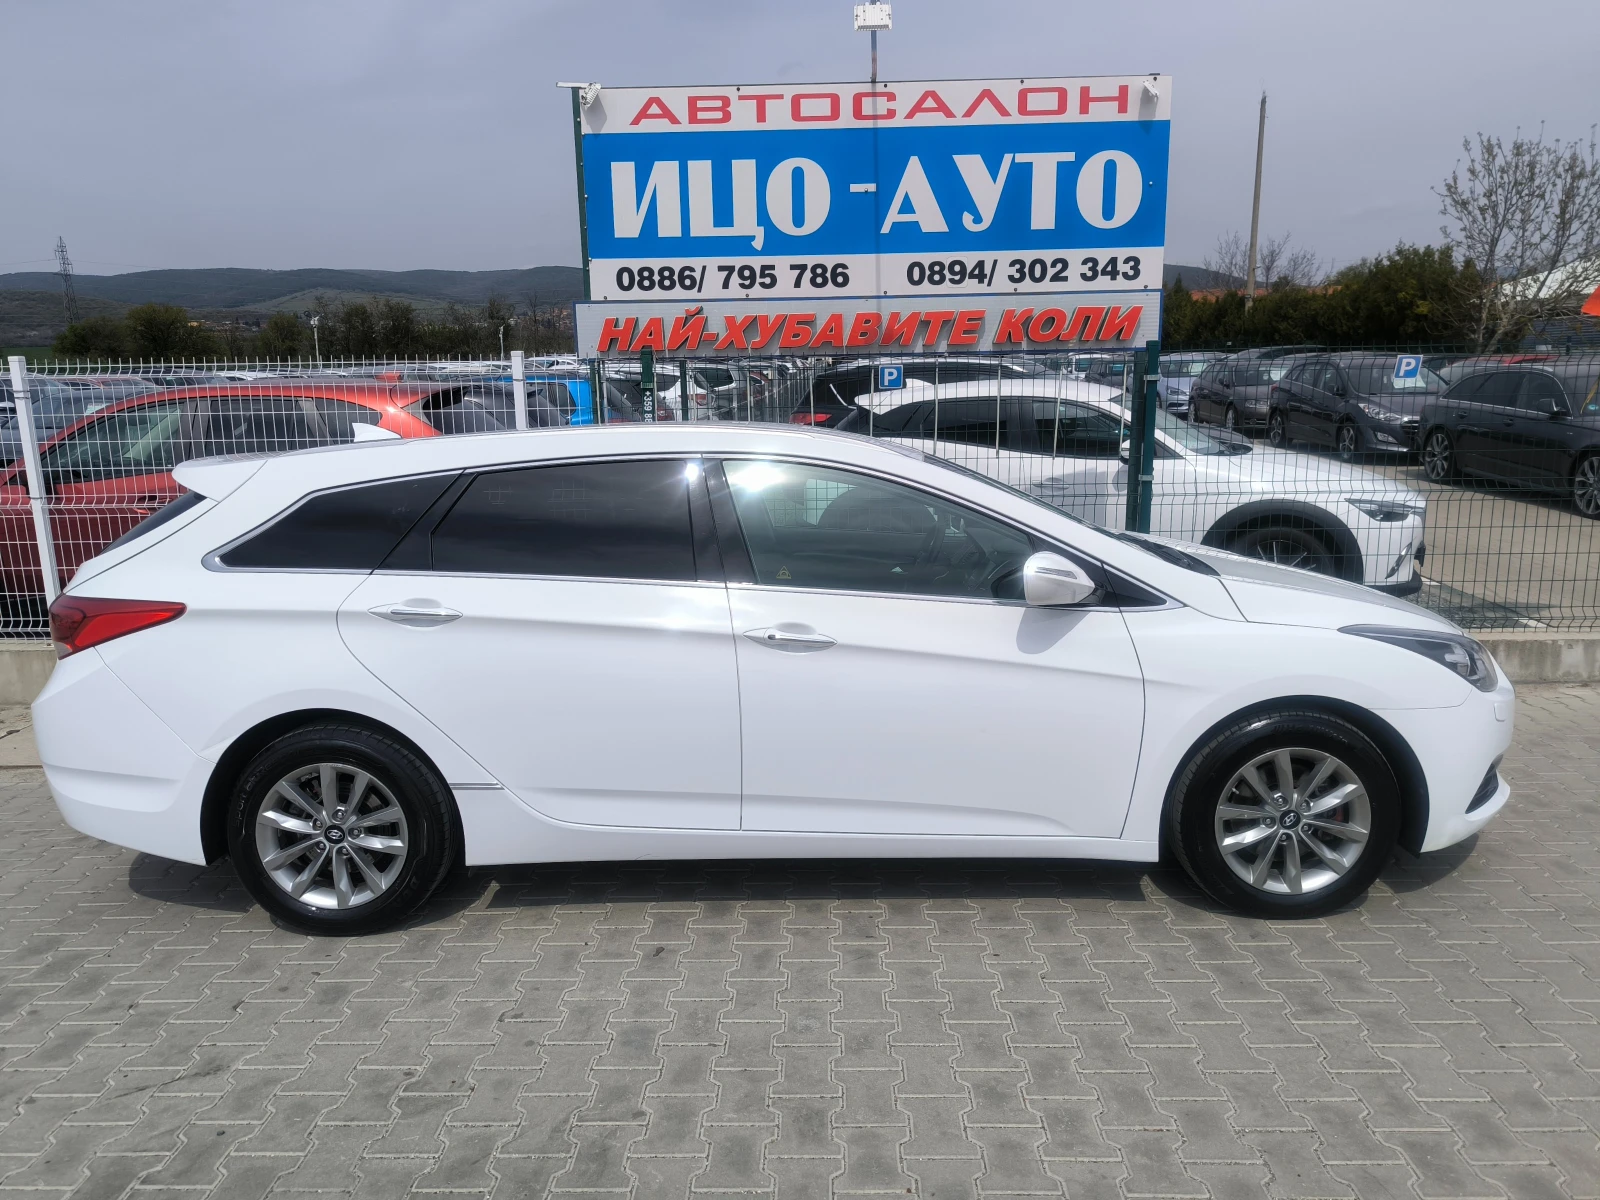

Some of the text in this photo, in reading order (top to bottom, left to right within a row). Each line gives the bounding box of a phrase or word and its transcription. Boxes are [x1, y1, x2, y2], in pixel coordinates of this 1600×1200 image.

[630, 84, 1129, 126] АВТОСАЛОН
[616, 262, 850, 293] 0886/ 795 786
[906, 255, 1141, 287] 0894/ 302 343
[596, 304, 1144, 354] НАЙ-ХУБАВИТЕ КОЛИ
[883, 368, 898, 386] P
[1398, 358, 1416, 377] P
[643, 390, 653, 411] +359
